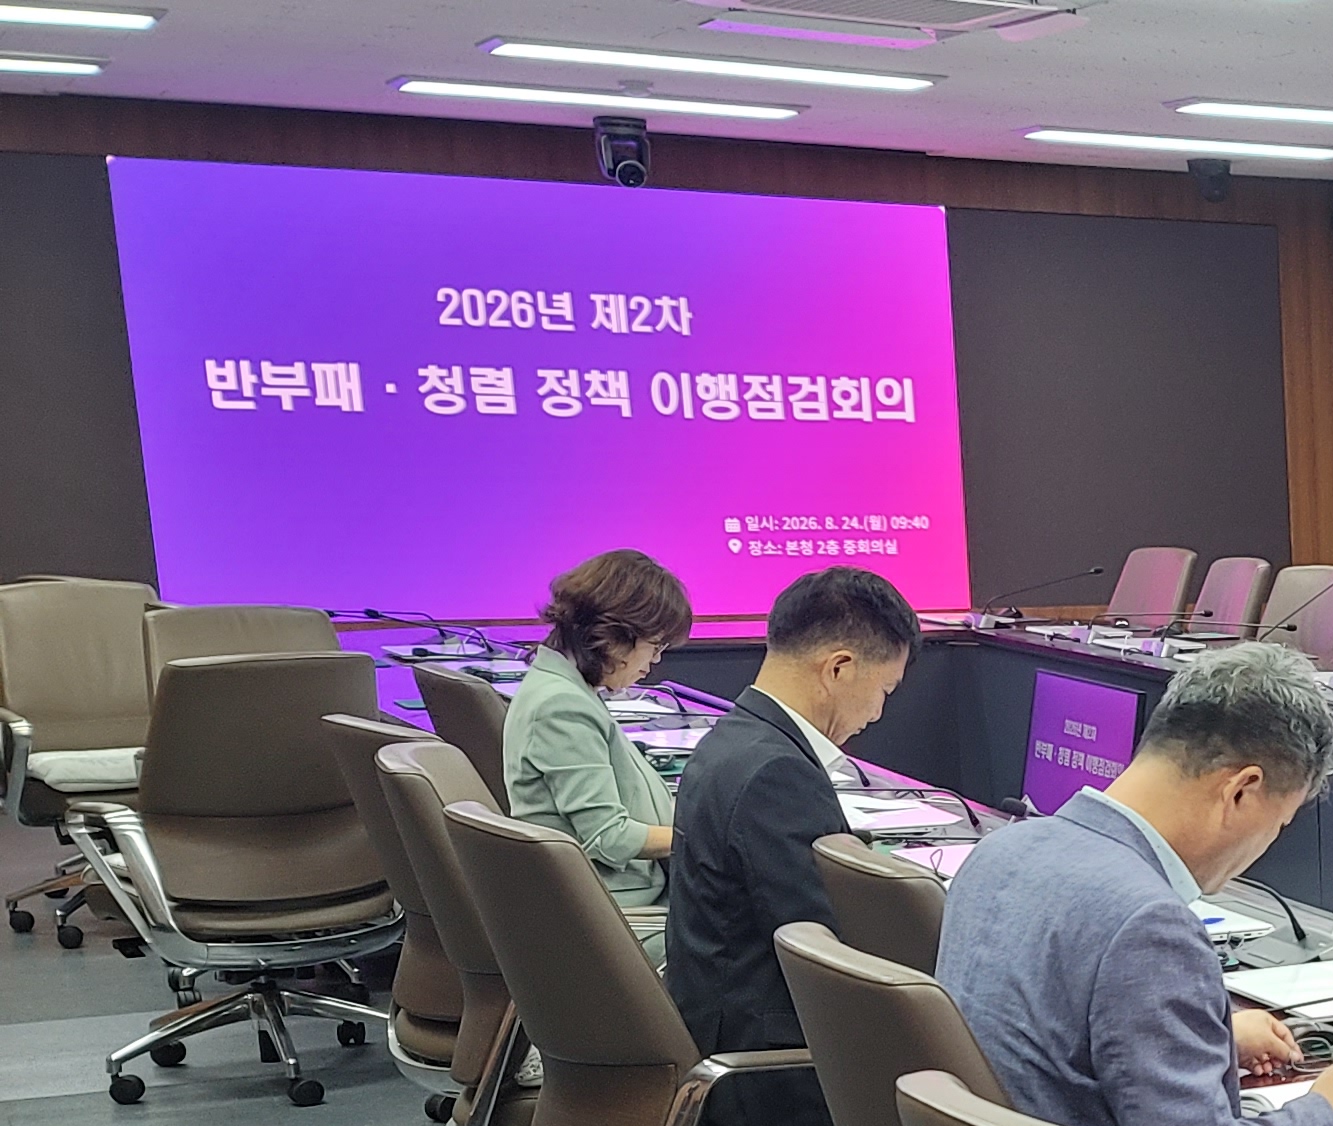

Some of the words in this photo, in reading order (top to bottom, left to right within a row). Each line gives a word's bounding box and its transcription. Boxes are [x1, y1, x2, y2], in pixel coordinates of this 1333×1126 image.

[436, 286, 576, 332] 2026년
[589, 291, 694, 337] 제2차
[205, 358, 365, 413] 반부패
[418, 364, 518, 416] 청렴
[536, 368, 633, 418] 정책
[651, 371, 917, 424] 이행점검회의
[745, 514, 780, 531] 일시:
[782, 516, 823, 531] 2026.
[824, 516, 840, 530] 8.
[841, 514, 887, 532] 24.(월)
[891, 515, 930, 530] 09:40
[748, 540, 783, 557] 장소:
[785, 540, 814, 556] 본청
[816, 540, 841, 556] 2층
[843, 538, 898, 556] 중회의실
